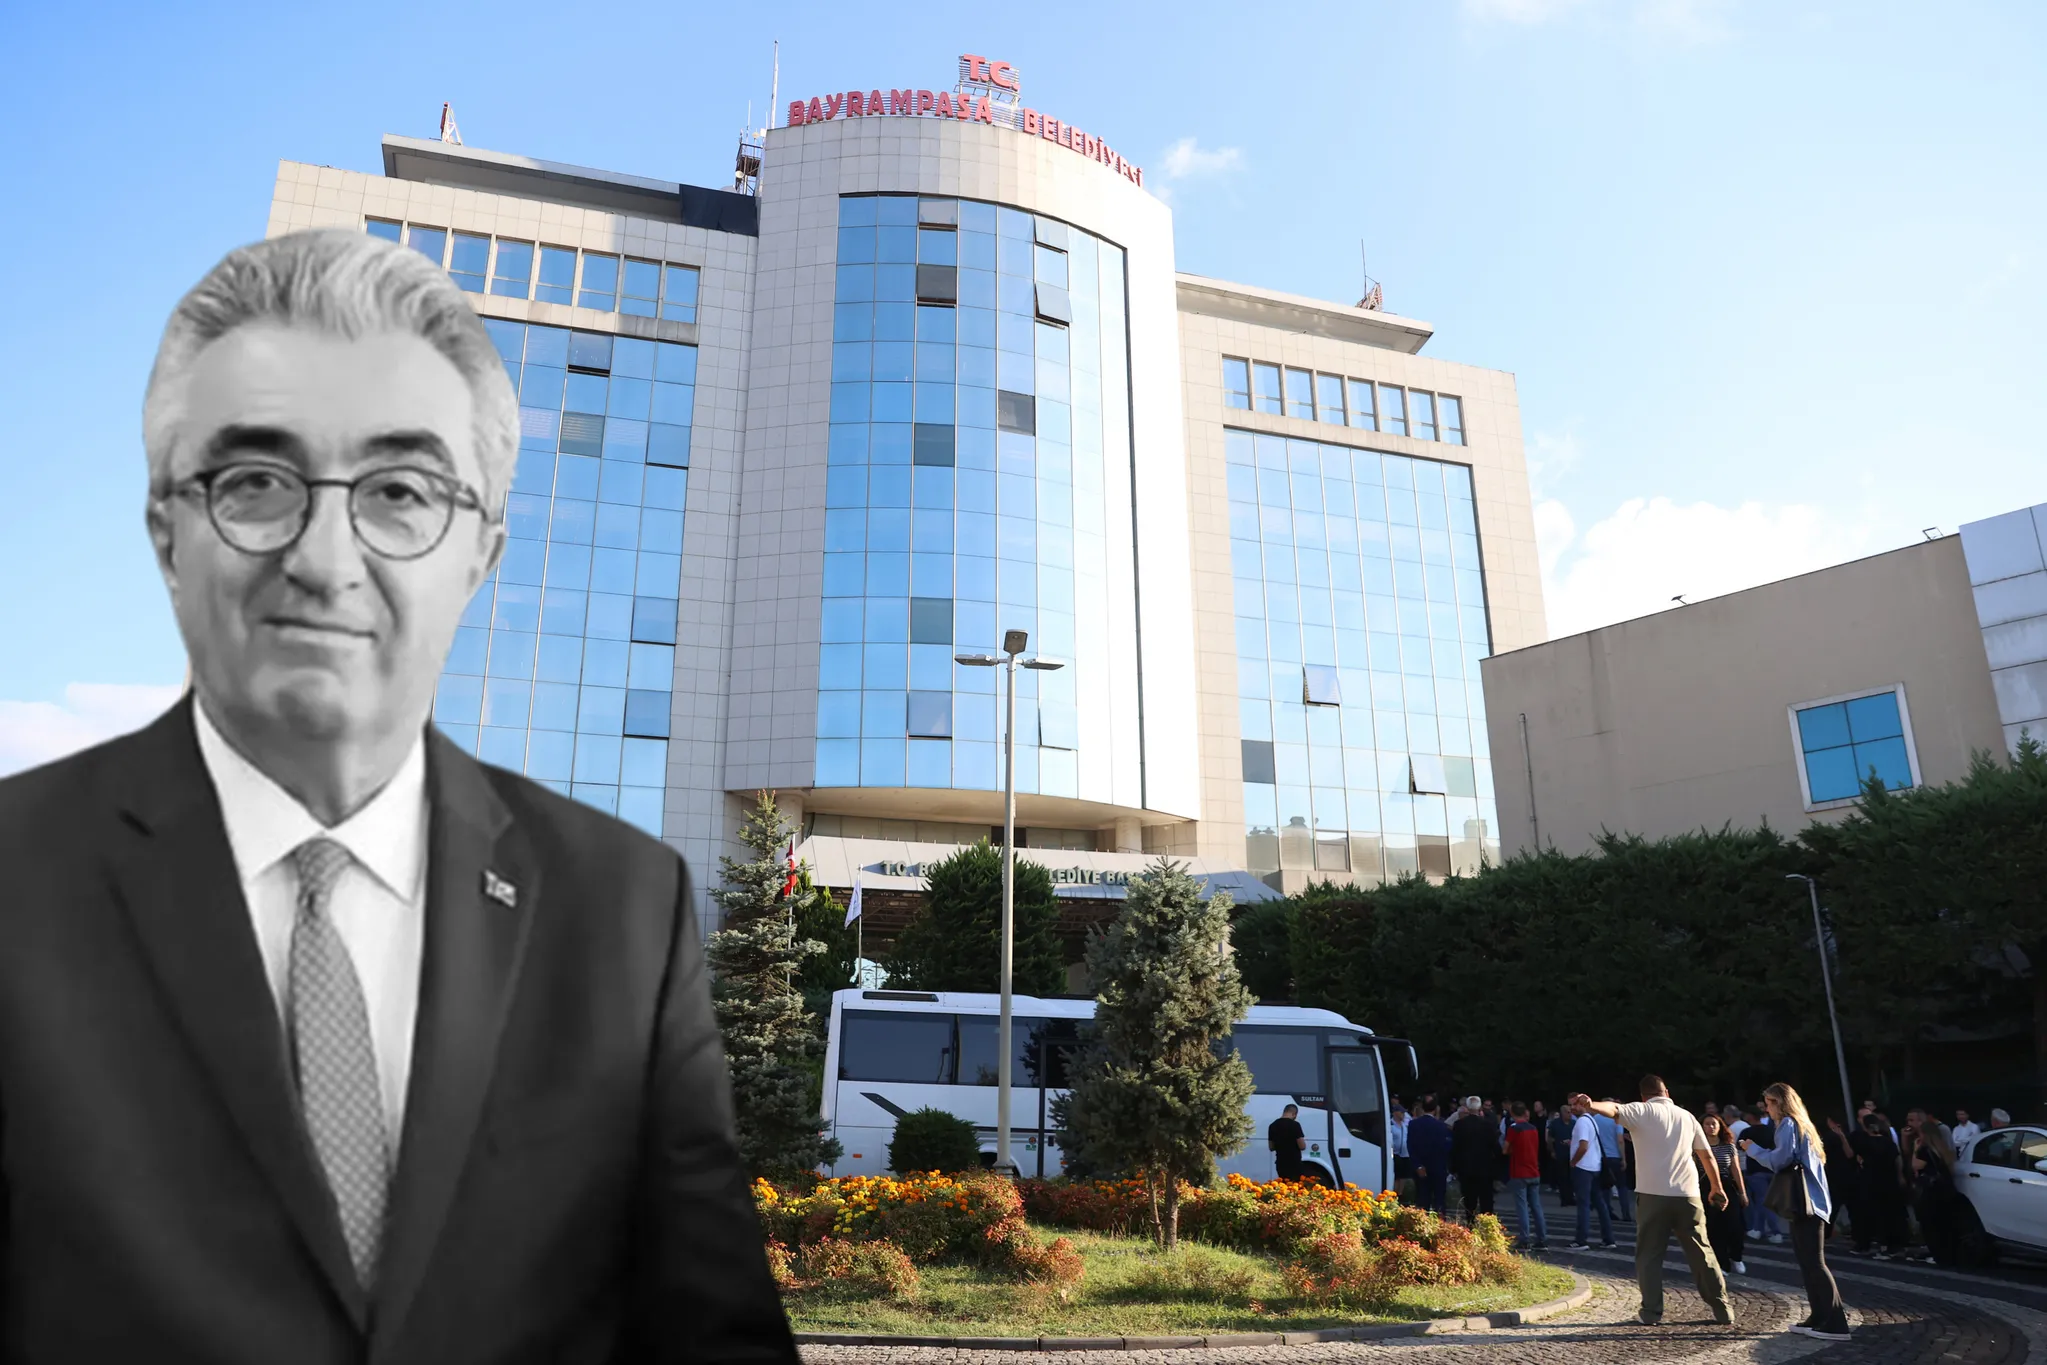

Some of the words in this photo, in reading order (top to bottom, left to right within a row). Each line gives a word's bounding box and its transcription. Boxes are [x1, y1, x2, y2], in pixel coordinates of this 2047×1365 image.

[962, 53, 1020, 91] T.C.
[882, 860, 914, 877] T.C.
[1049, 865, 1101, 885] LEDİYE
